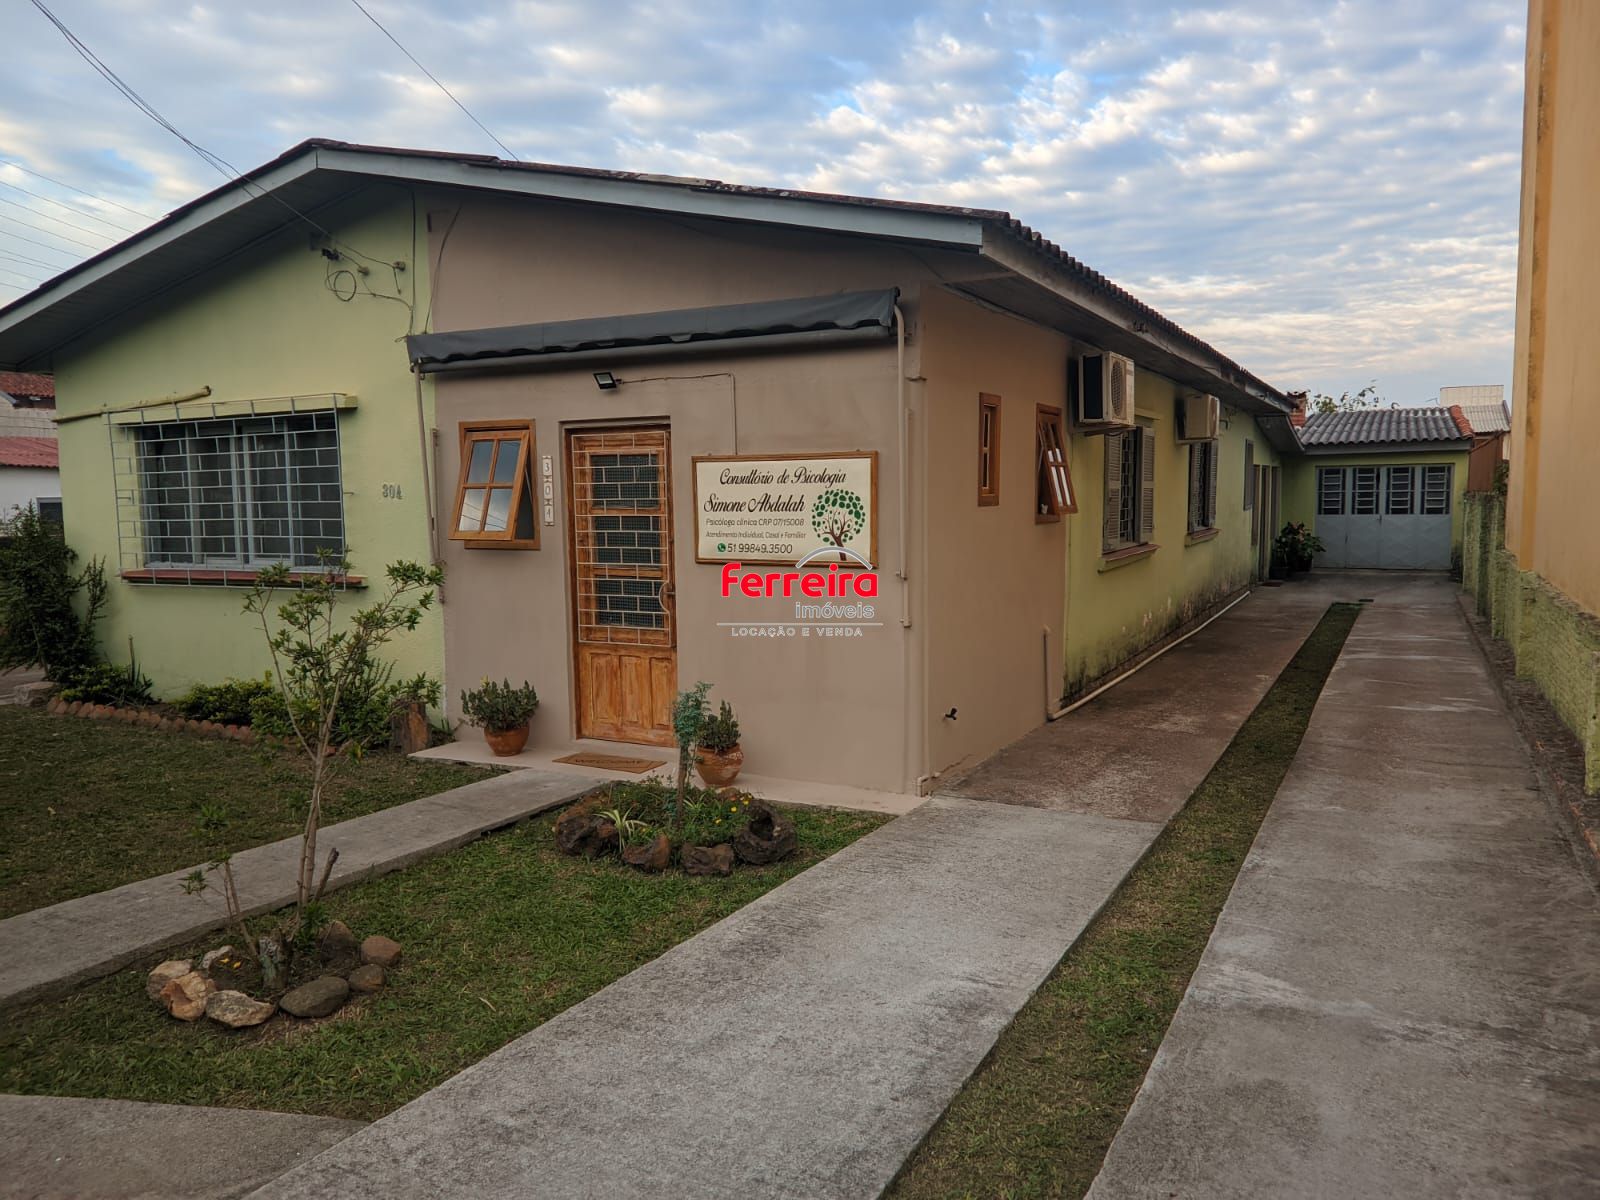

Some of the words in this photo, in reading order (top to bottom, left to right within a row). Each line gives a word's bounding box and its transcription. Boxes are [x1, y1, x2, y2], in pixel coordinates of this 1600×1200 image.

[719, 468, 774, 485] Consultório
[776, 468, 789, 485] de
[790, 466, 847, 488] Psicologia
[382, 483, 403, 500] 304
[703, 493, 747, 513] Simone
[747, 492, 806, 513] Abdalah
[736, 517, 757, 526] clínica
[758, 518, 772, 526] CRP
[773, 518, 805, 527] 07/15008
[727, 543, 736, 553] 51
[738, 543, 793, 554] 99849.3500
